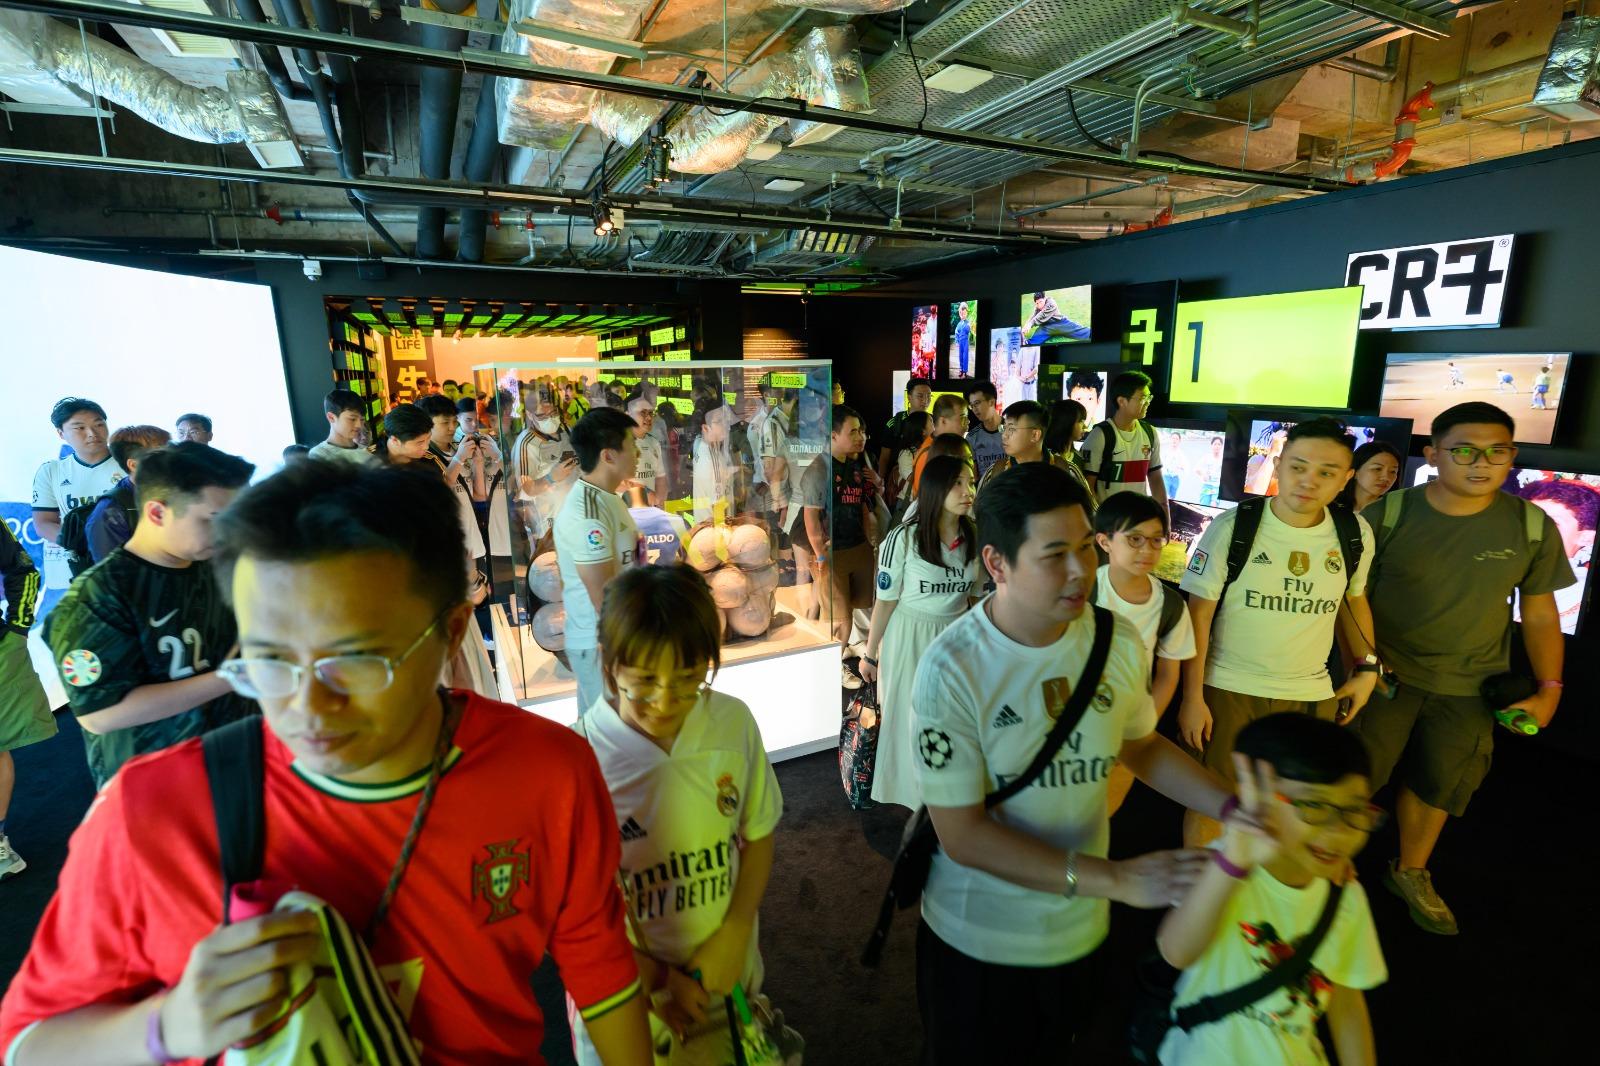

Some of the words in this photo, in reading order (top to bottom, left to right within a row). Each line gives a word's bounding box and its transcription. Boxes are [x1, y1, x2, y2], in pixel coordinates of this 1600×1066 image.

[396, 339, 421, 350] LIFE
[1187, 320, 1204, 384] 1
[1112, 463, 1123, 481] 7
[646, 533, 675, 545] ALDO
[945, 566, 965, 579] Fly
[1283, 577, 1314, 595] Fly
[1245, 588, 1339, 615] Emirates
[157, 627, 211, 681] 22
[636, 887, 667, 919] FLY
